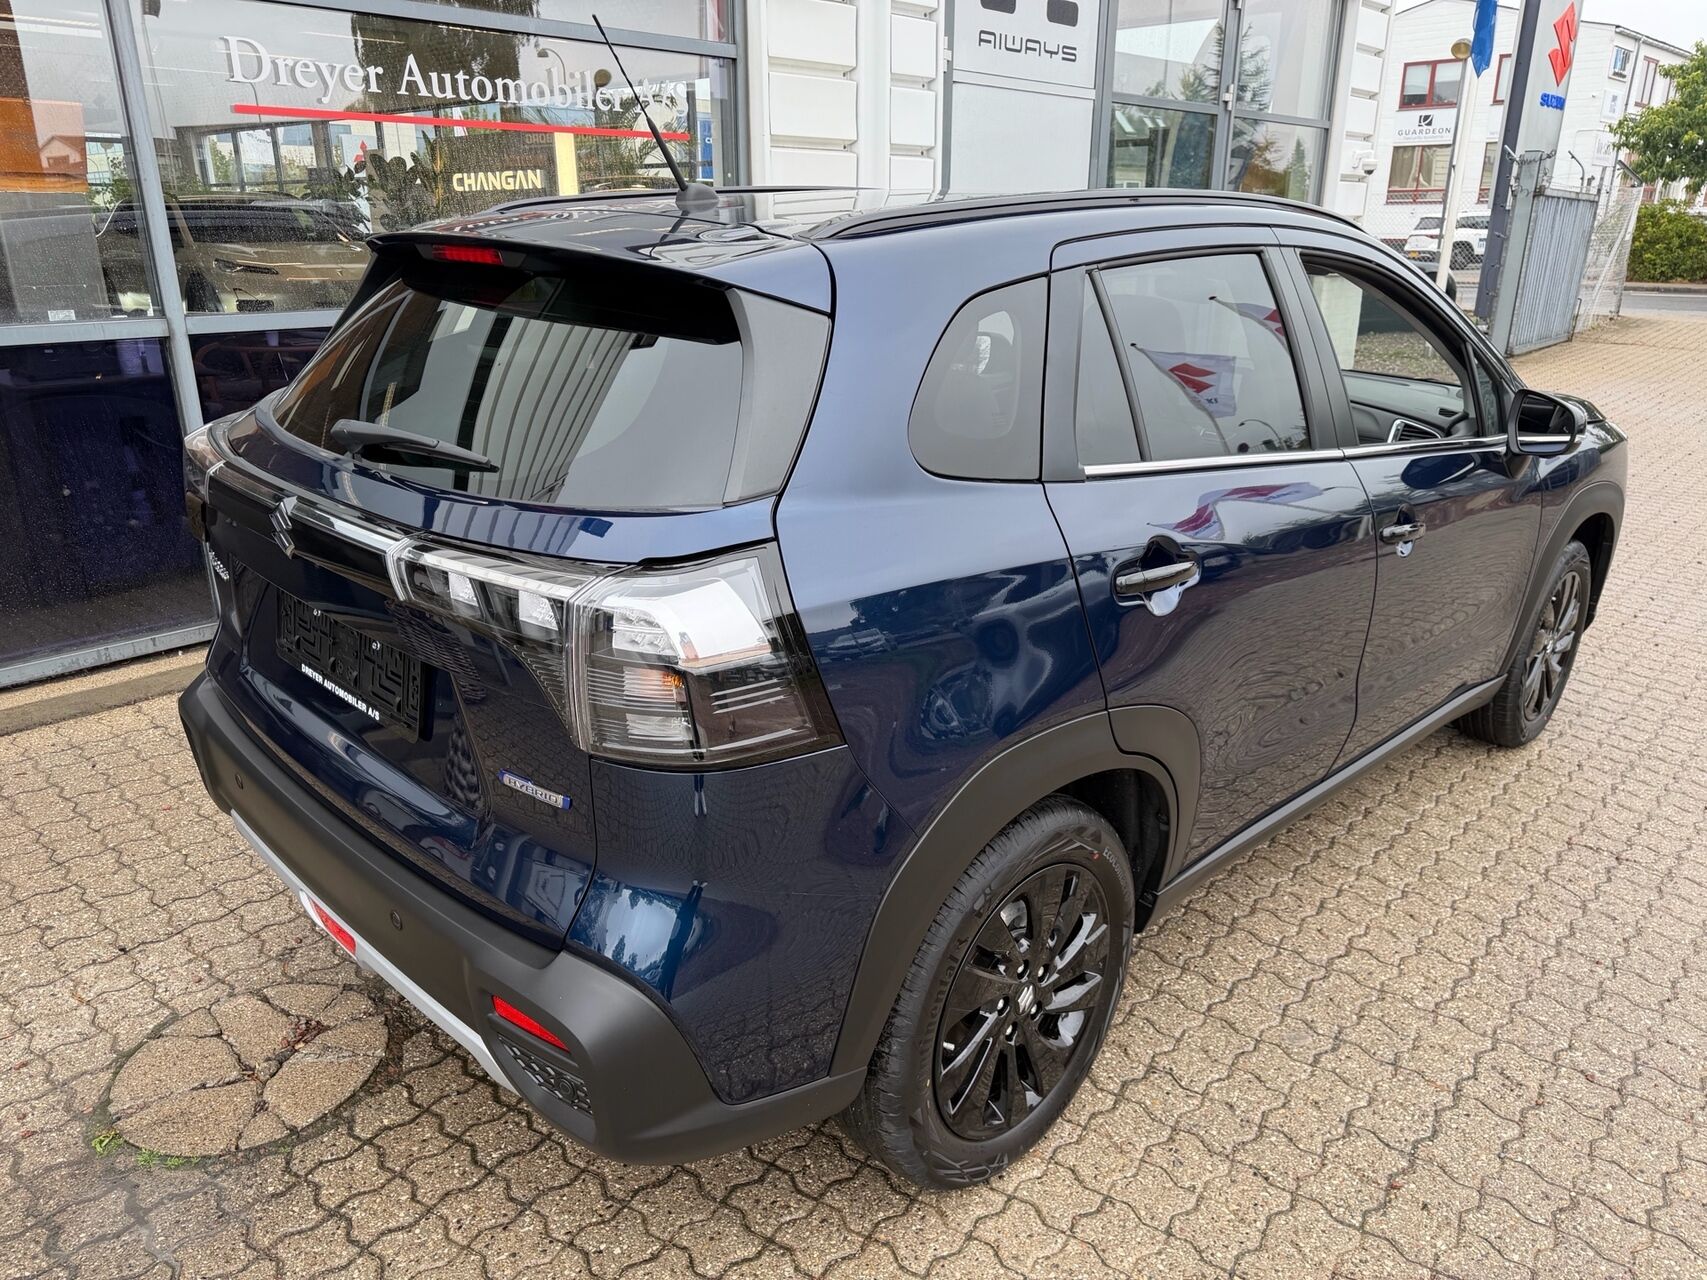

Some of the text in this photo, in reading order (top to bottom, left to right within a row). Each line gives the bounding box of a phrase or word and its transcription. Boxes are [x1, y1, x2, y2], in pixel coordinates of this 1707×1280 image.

[978, 29, 1077, 62] AIWAYS
[220, 35, 384, 105] Dreyer
[397, 52, 624, 113] Automobiler
[1397, 127, 1452, 137] GUARDEON
[452, 169, 542, 192] CHANGAN
[301, 663, 380, 721] DREYER AUTOMOBILER A/S
[507, 776, 559, 804] HYBRID
